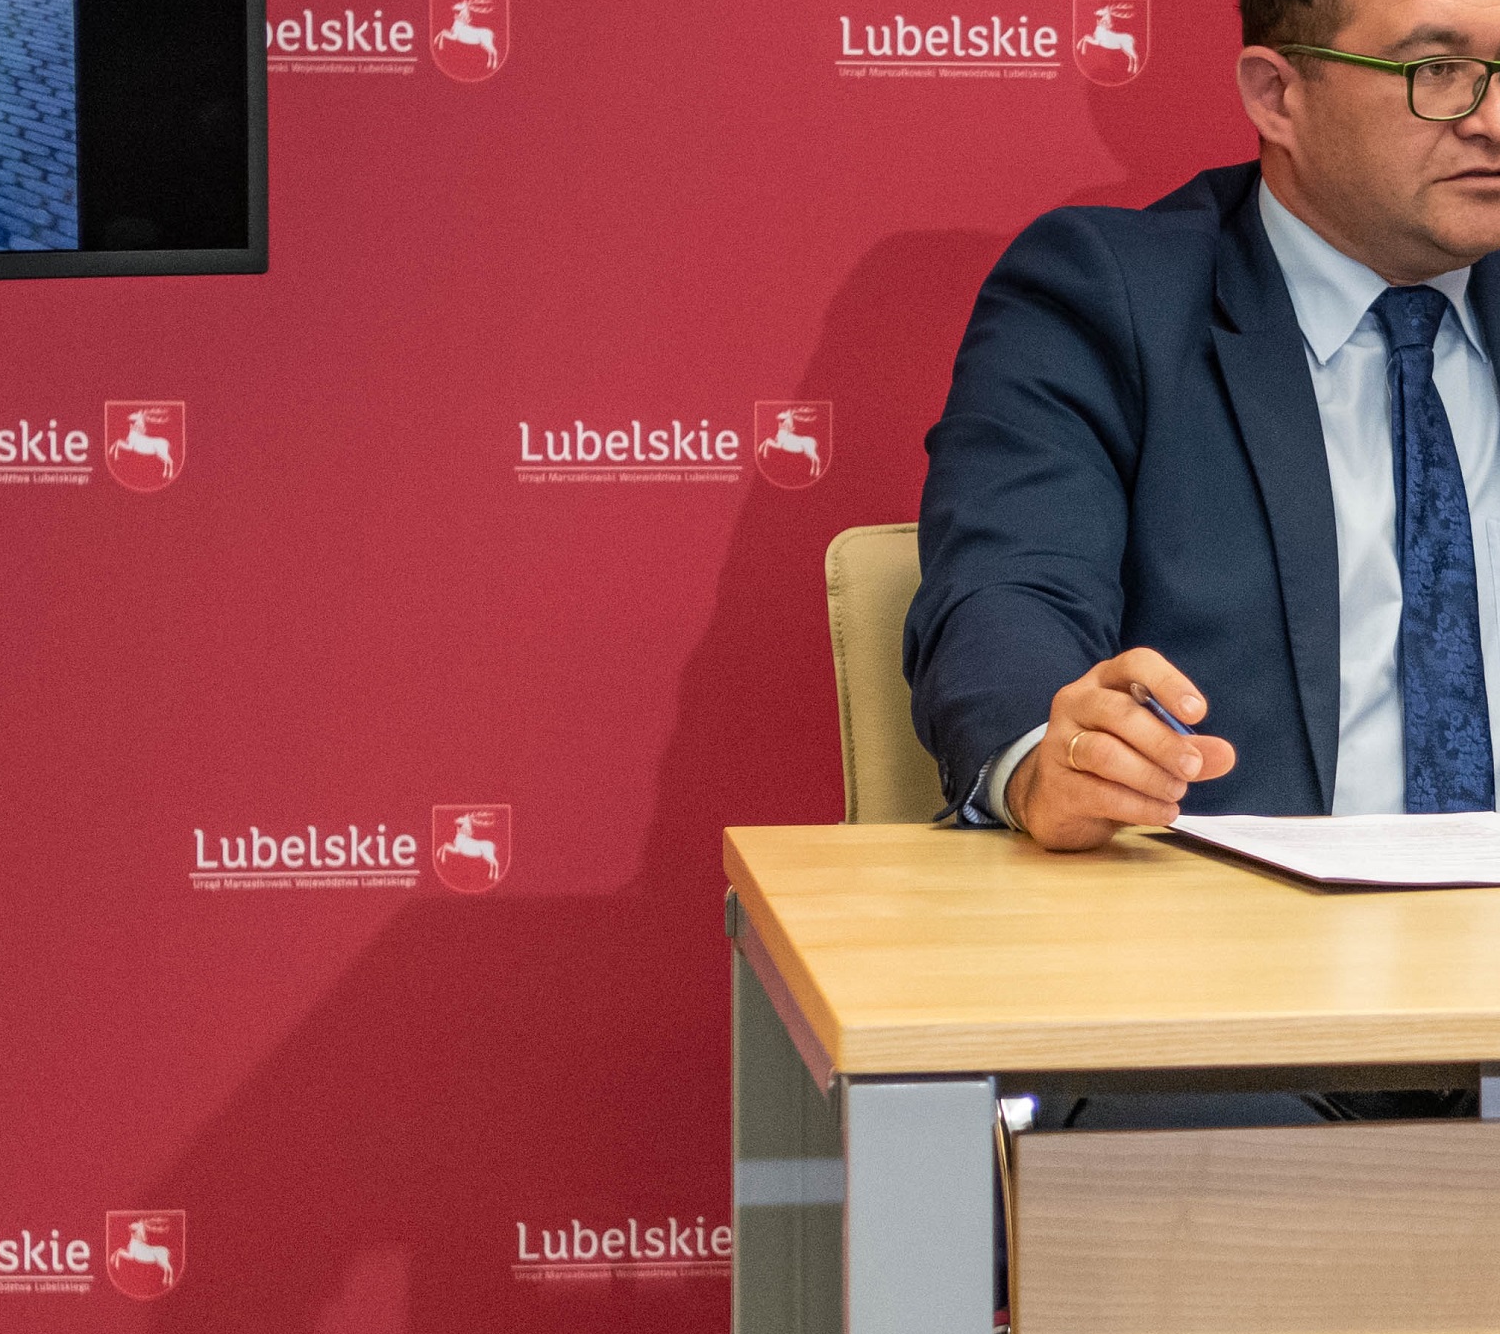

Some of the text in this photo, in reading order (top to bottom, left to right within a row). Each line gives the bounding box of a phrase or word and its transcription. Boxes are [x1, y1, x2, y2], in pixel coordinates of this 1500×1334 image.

[266, 9, 414, 53] elskie
[839, 15, 1058, 58] Lubelskie
[519, 420, 739, 461] Lubelskie
[193, 824, 417, 869] Lubelskie
[516, 1217, 731, 1261] Lubelskie
